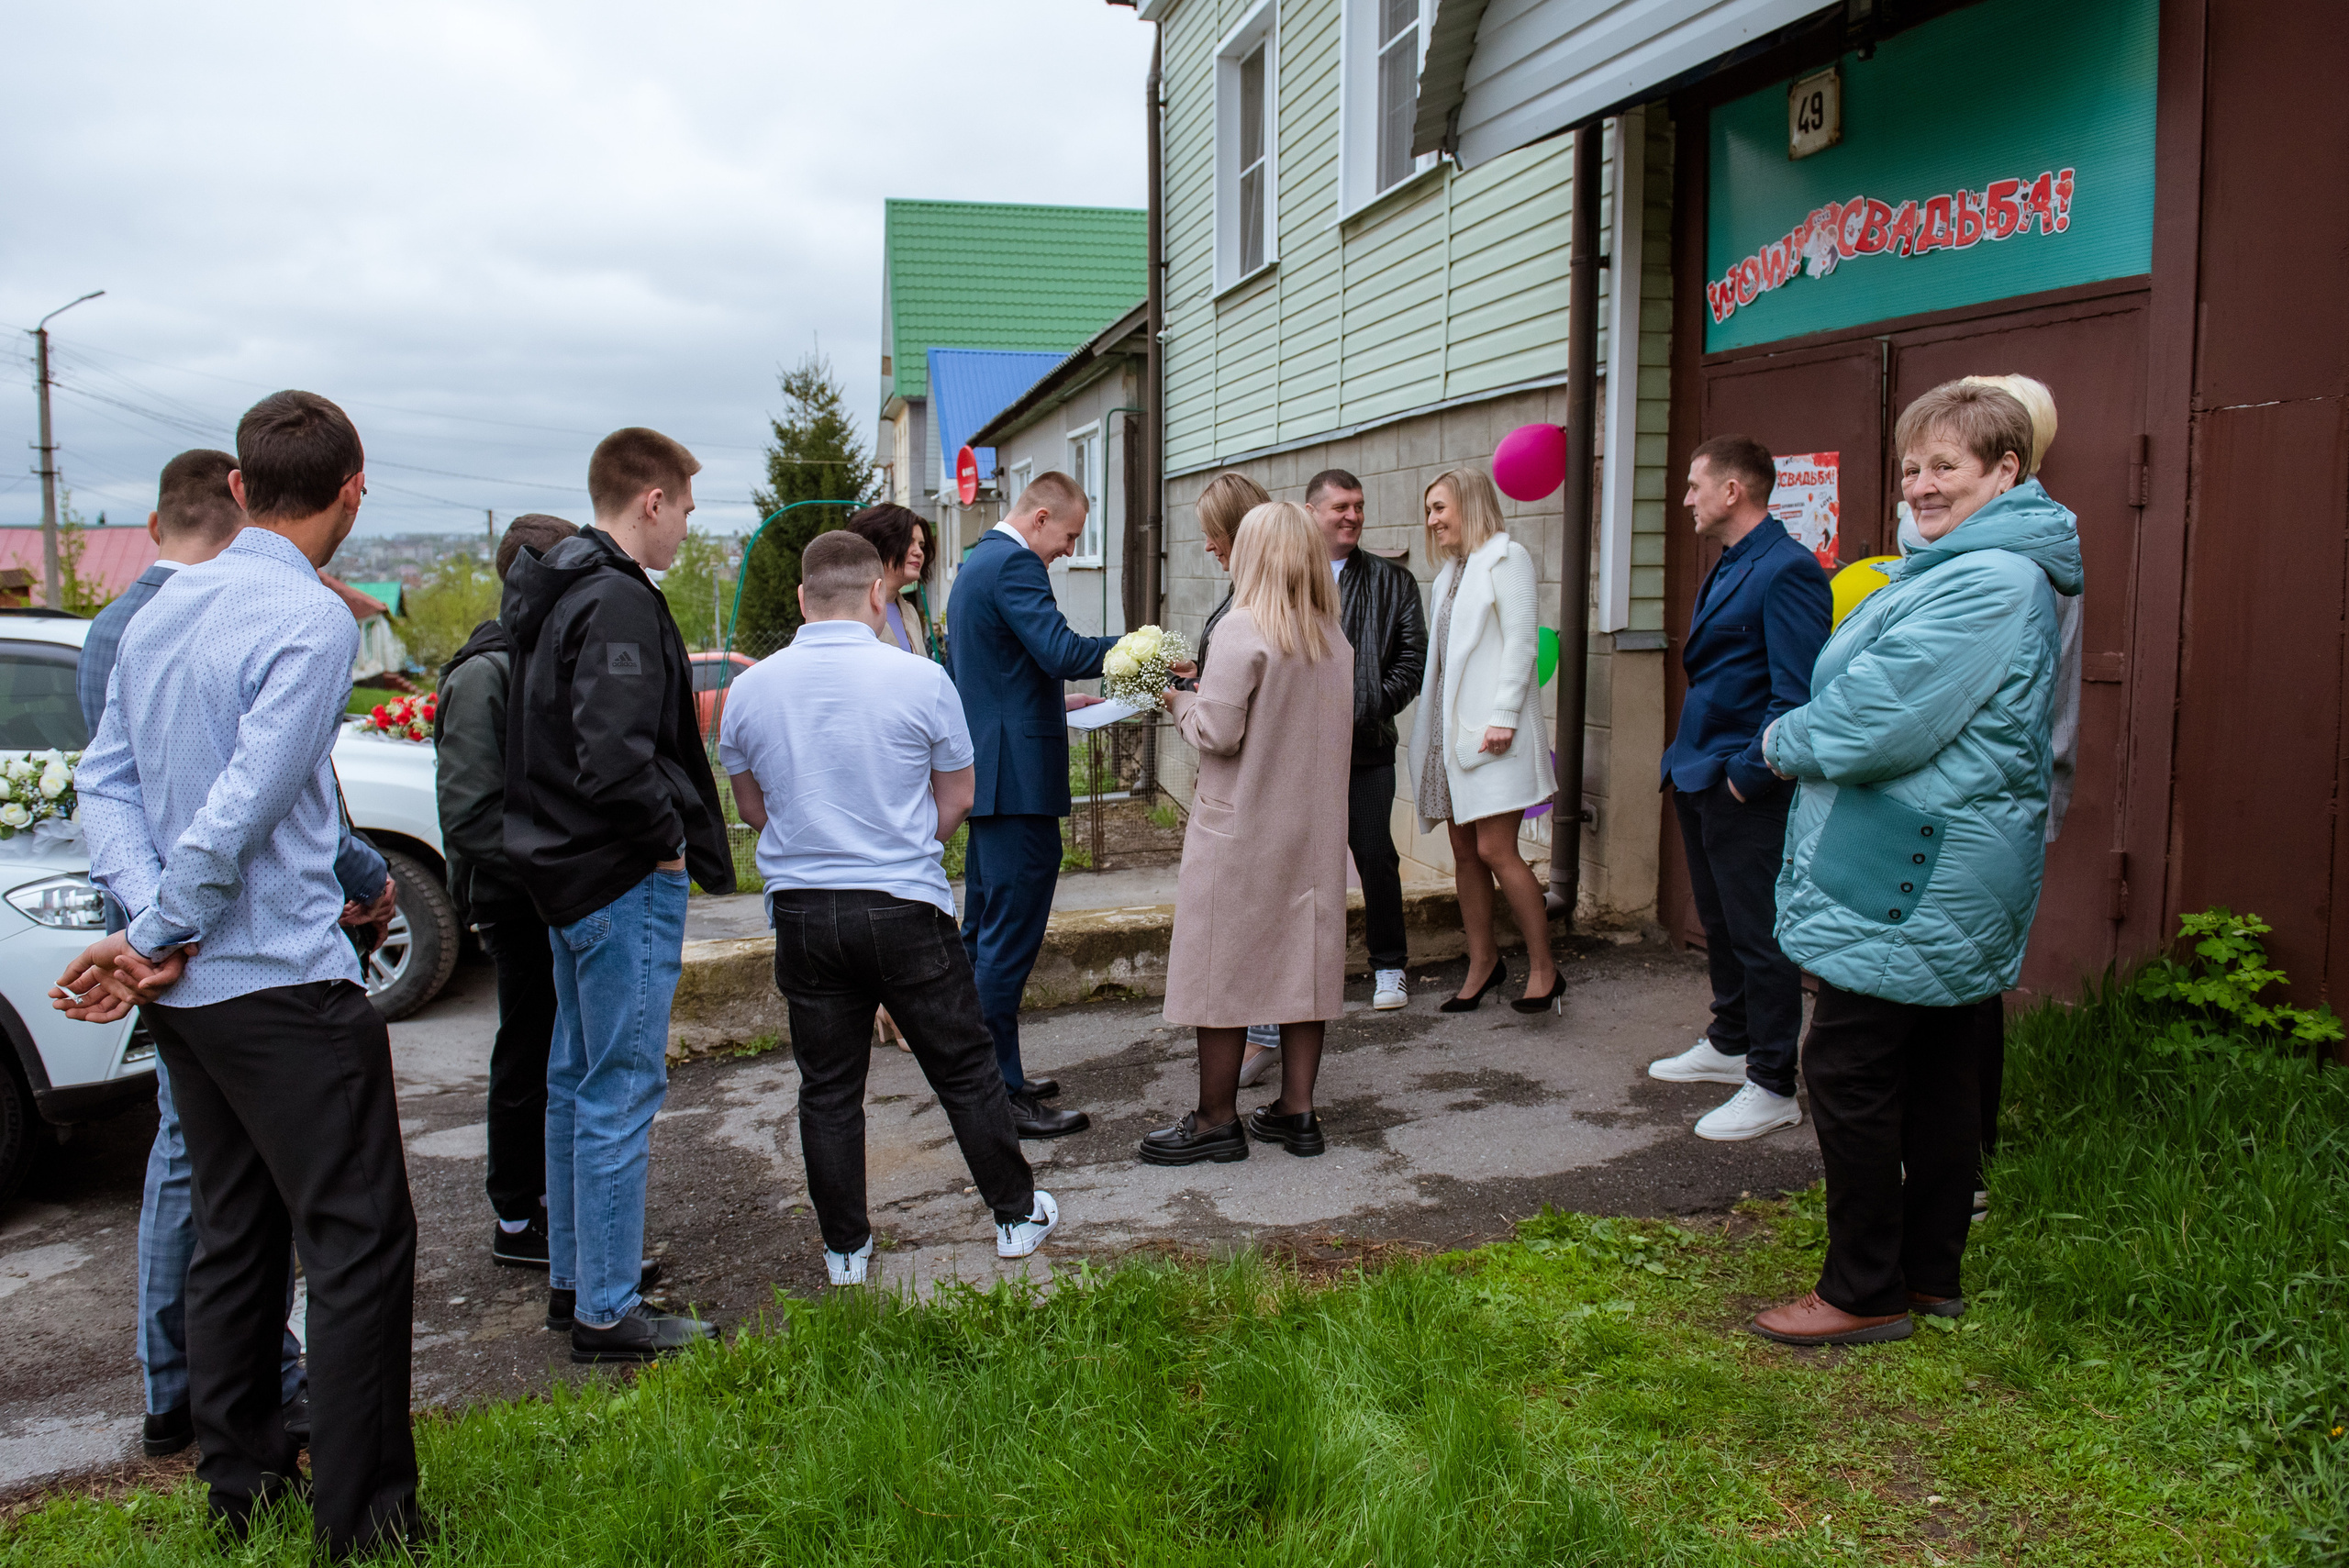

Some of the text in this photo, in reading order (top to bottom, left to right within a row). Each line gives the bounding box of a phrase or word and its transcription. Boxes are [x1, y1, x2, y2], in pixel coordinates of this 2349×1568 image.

[1798, 90, 1823, 134] 49
[1707, 167, 2075, 325] WOW! СВАДЬБА!
[1779, 469, 1835, 488] СВАДЬБА!
[1820, 495, 1833, 508] LOVE
